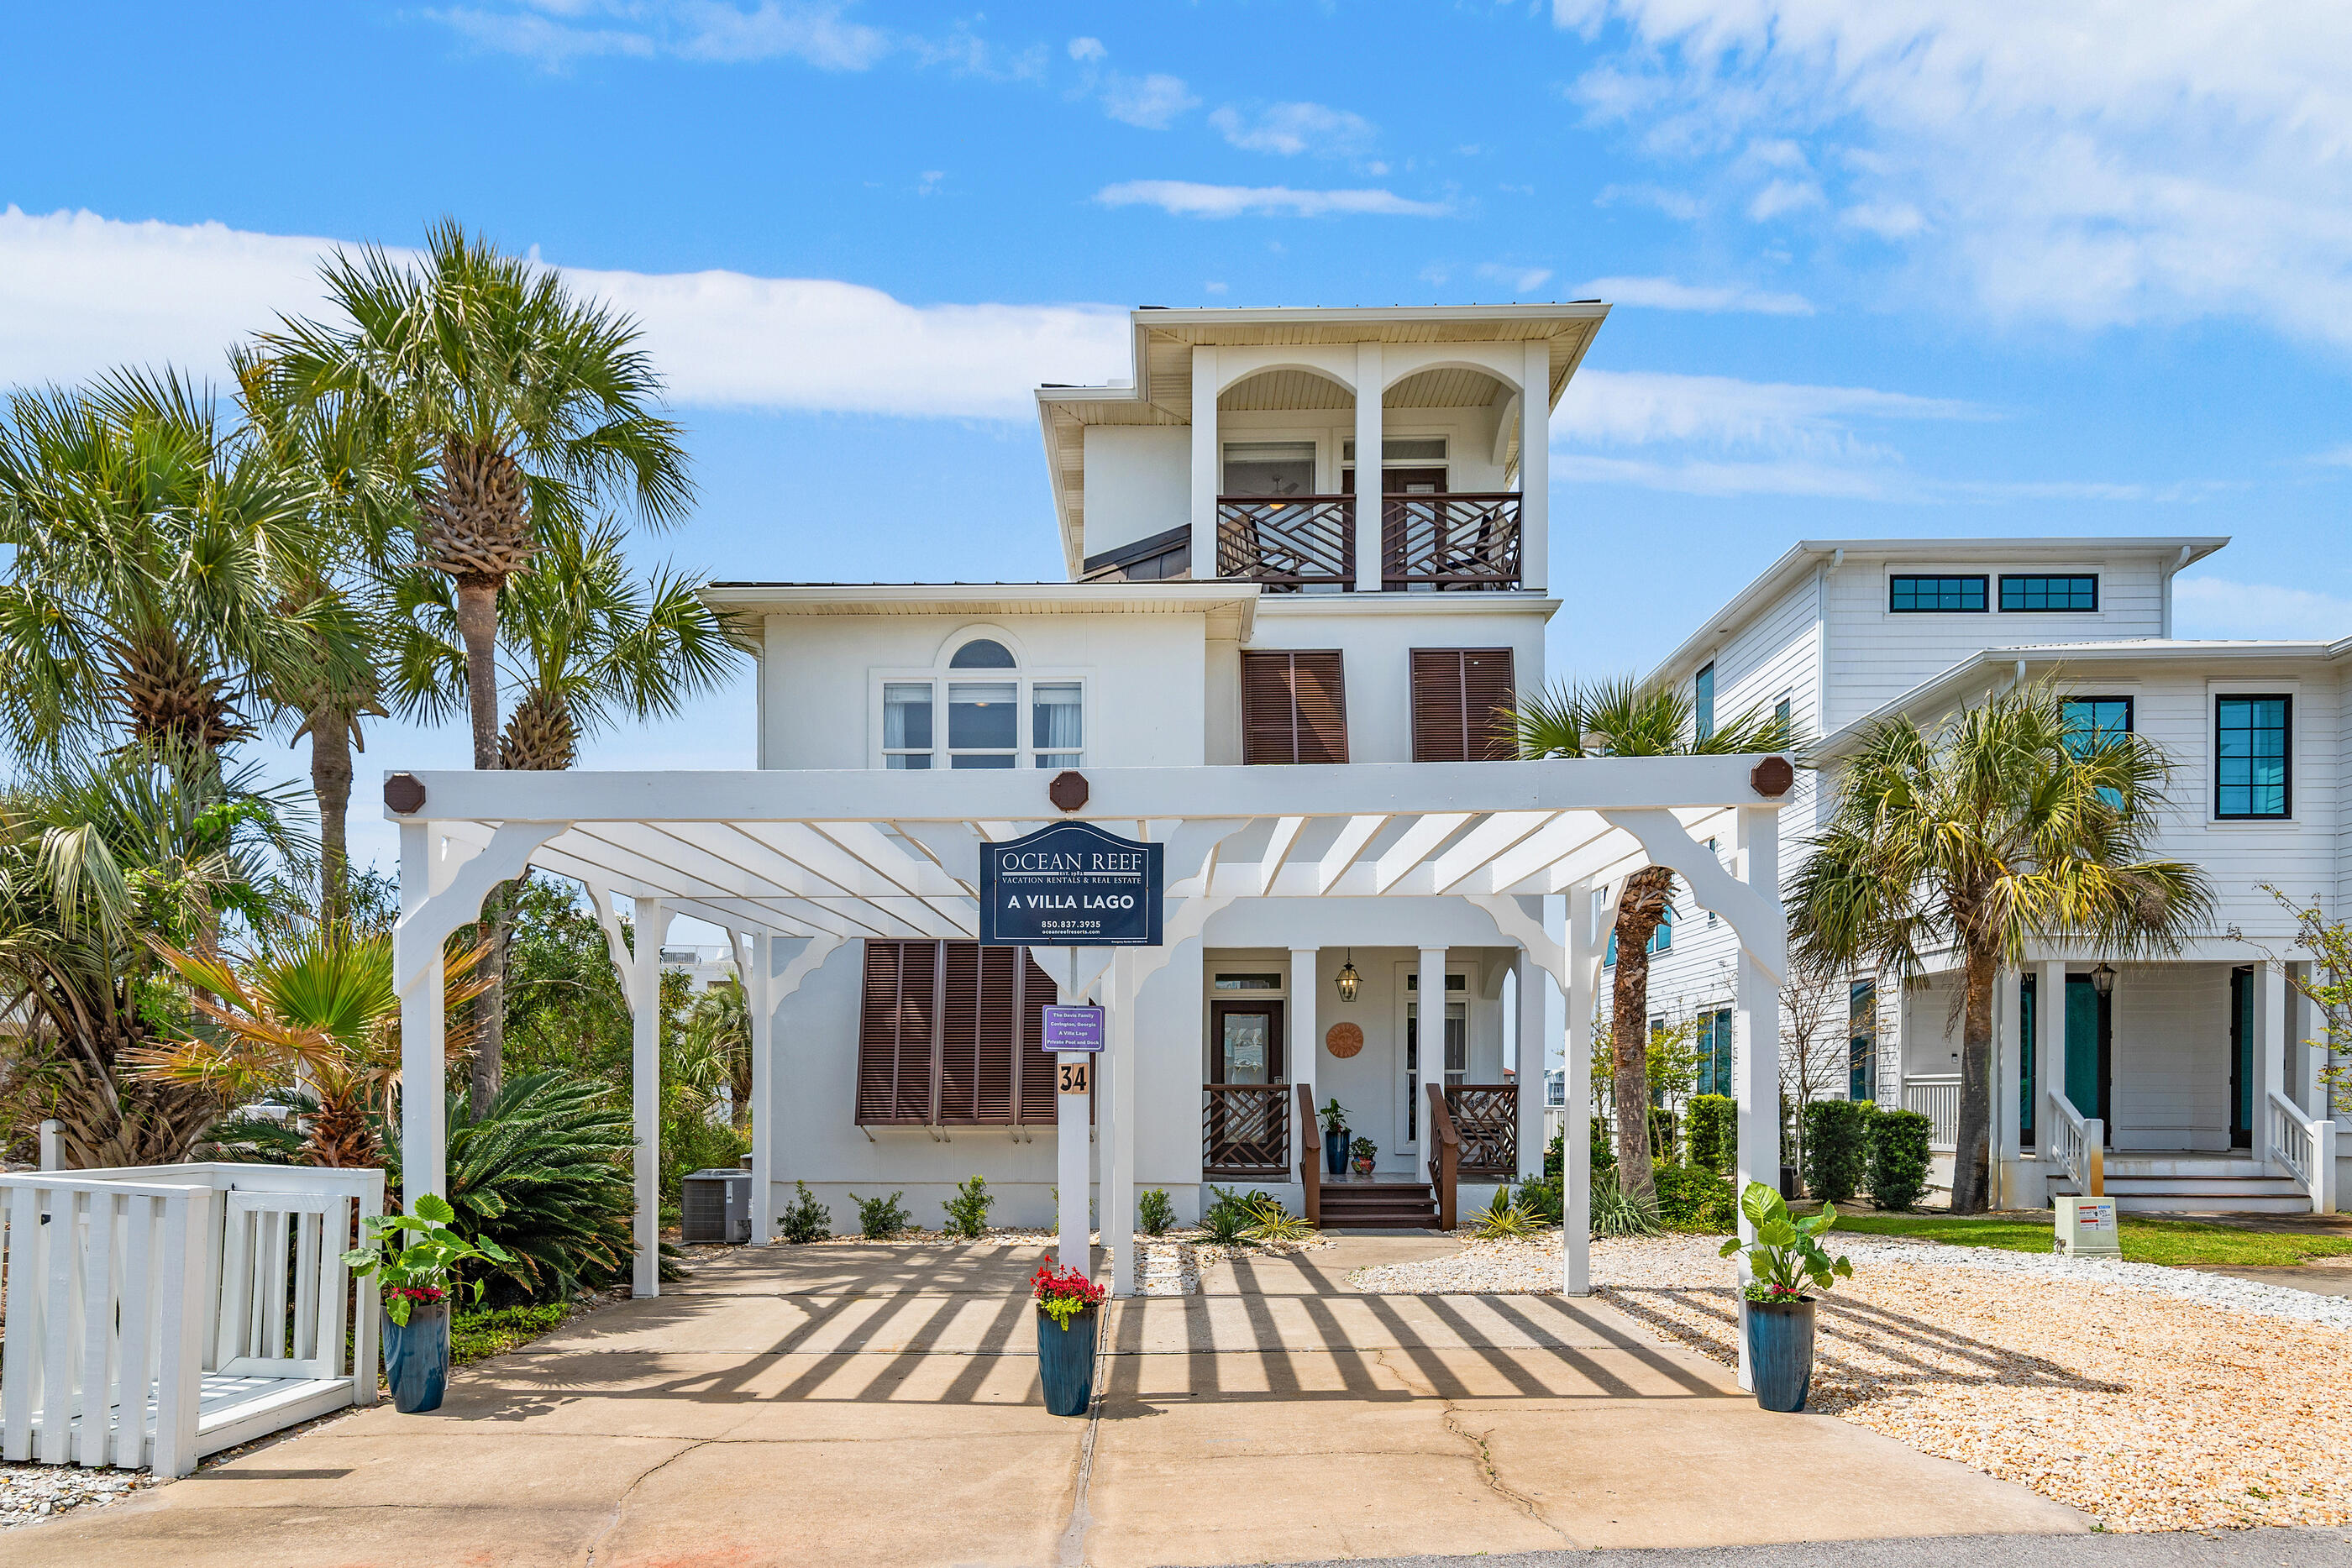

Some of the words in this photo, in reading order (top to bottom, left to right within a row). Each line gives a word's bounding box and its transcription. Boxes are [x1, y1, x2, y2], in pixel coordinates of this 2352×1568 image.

[1002, 852, 1083, 871] OCEAN
[1092, 853, 1142, 870] REEF
[1007, 895, 1021, 909] A
[1026, 895, 1078, 909] VILLA
[1084, 894, 1134, 910] LAGO
[1060, 1066, 1087, 1092] 34
